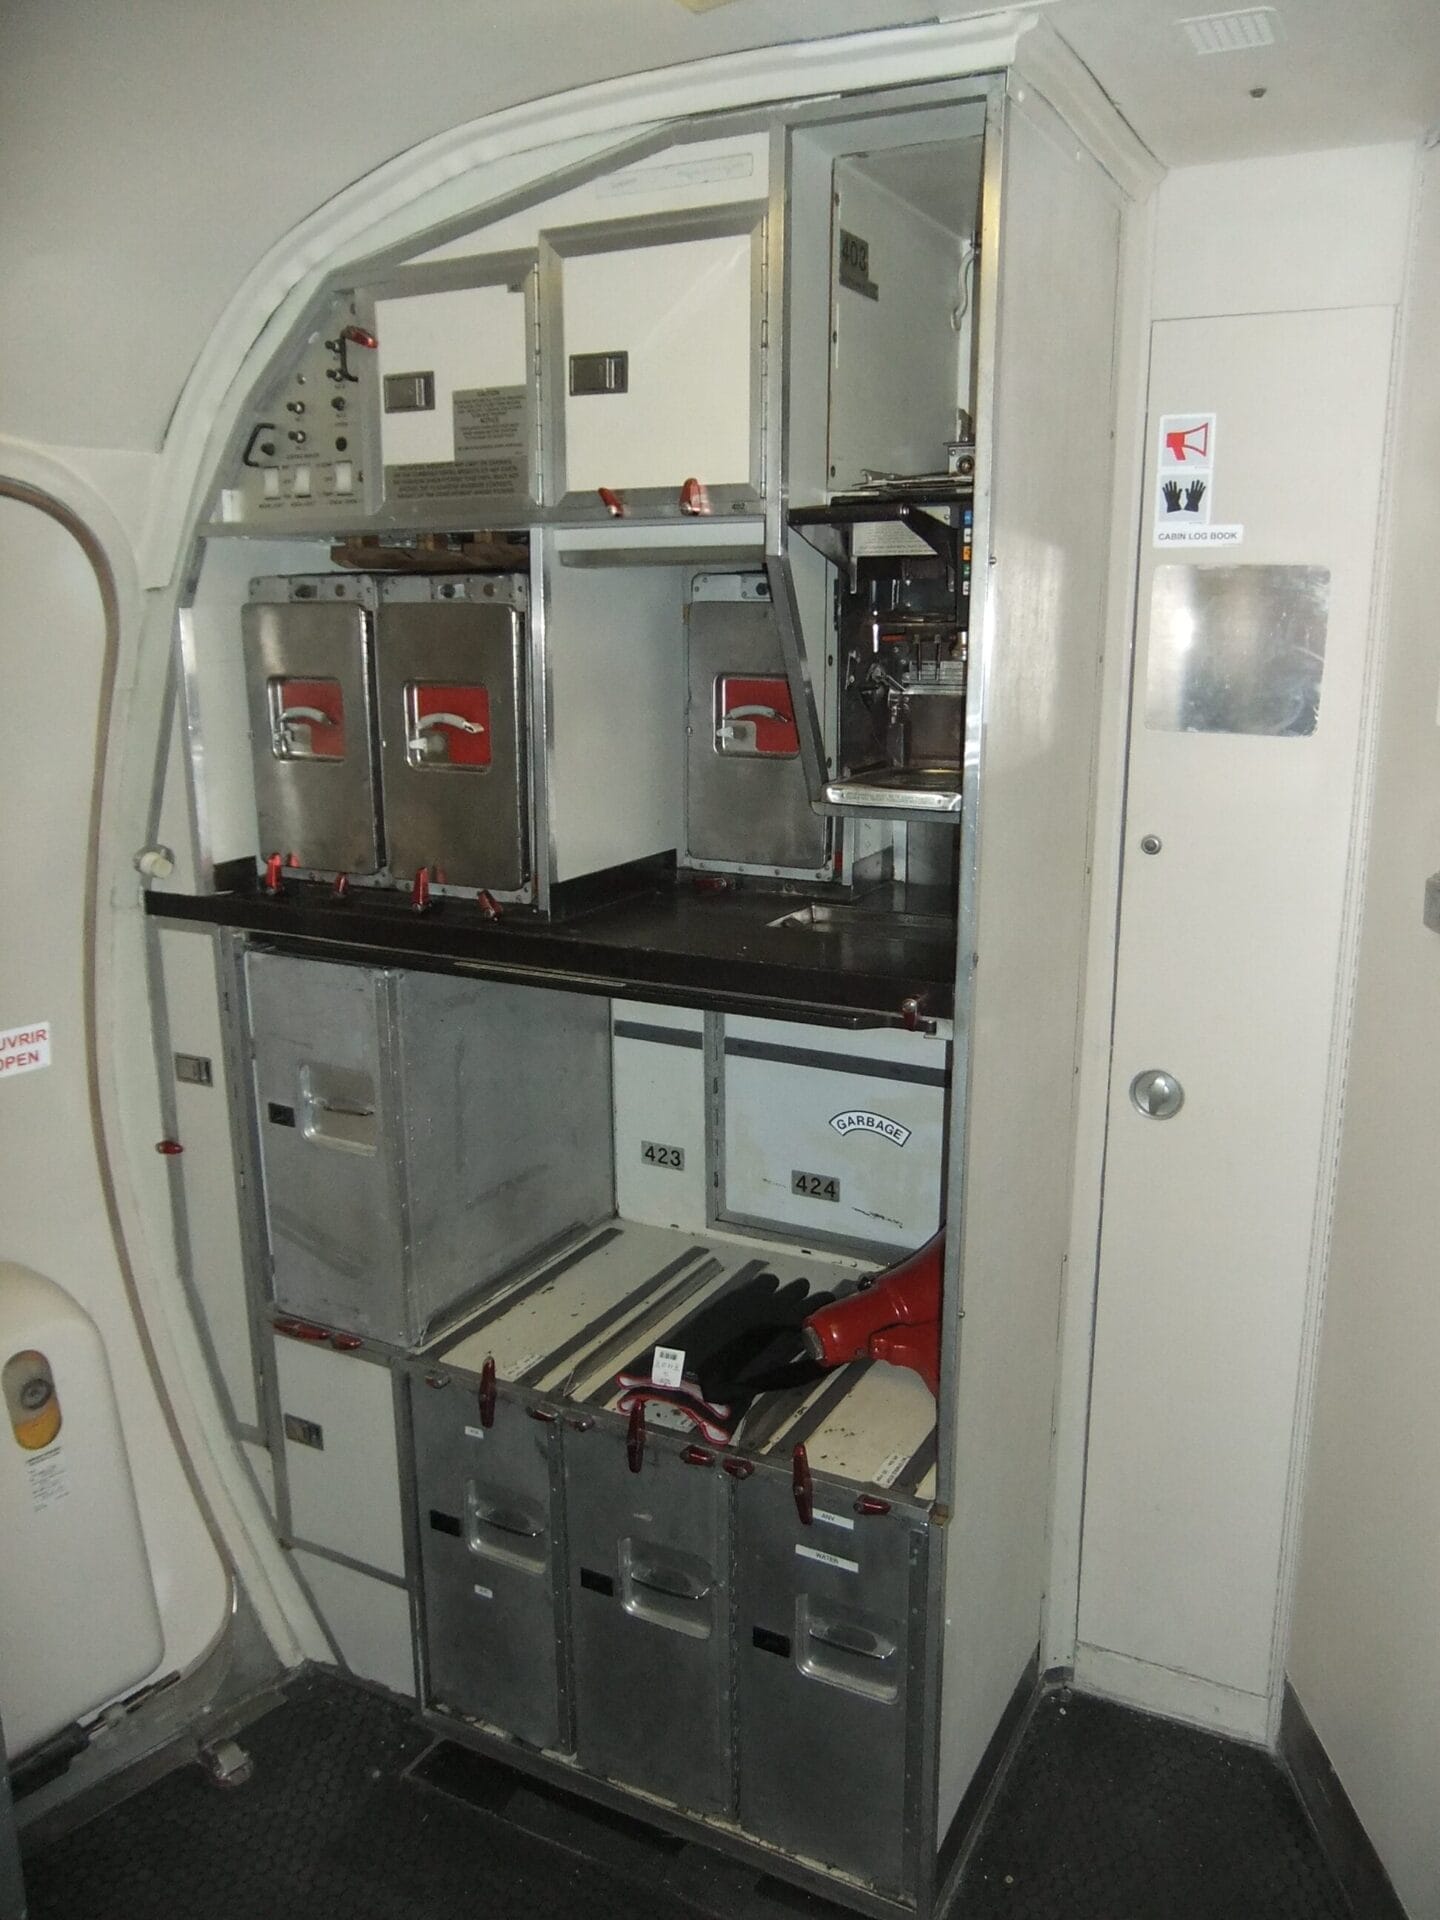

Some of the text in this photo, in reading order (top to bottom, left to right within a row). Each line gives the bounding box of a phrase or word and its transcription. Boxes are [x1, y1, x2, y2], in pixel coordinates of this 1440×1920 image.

[1158, 531, 1238, 541] CABIN LOG BOOK
[836, 1115, 904, 1140] GARBAGE
[645, 1145, 681, 1167] 423
[796, 1174, 836, 1198] 424
